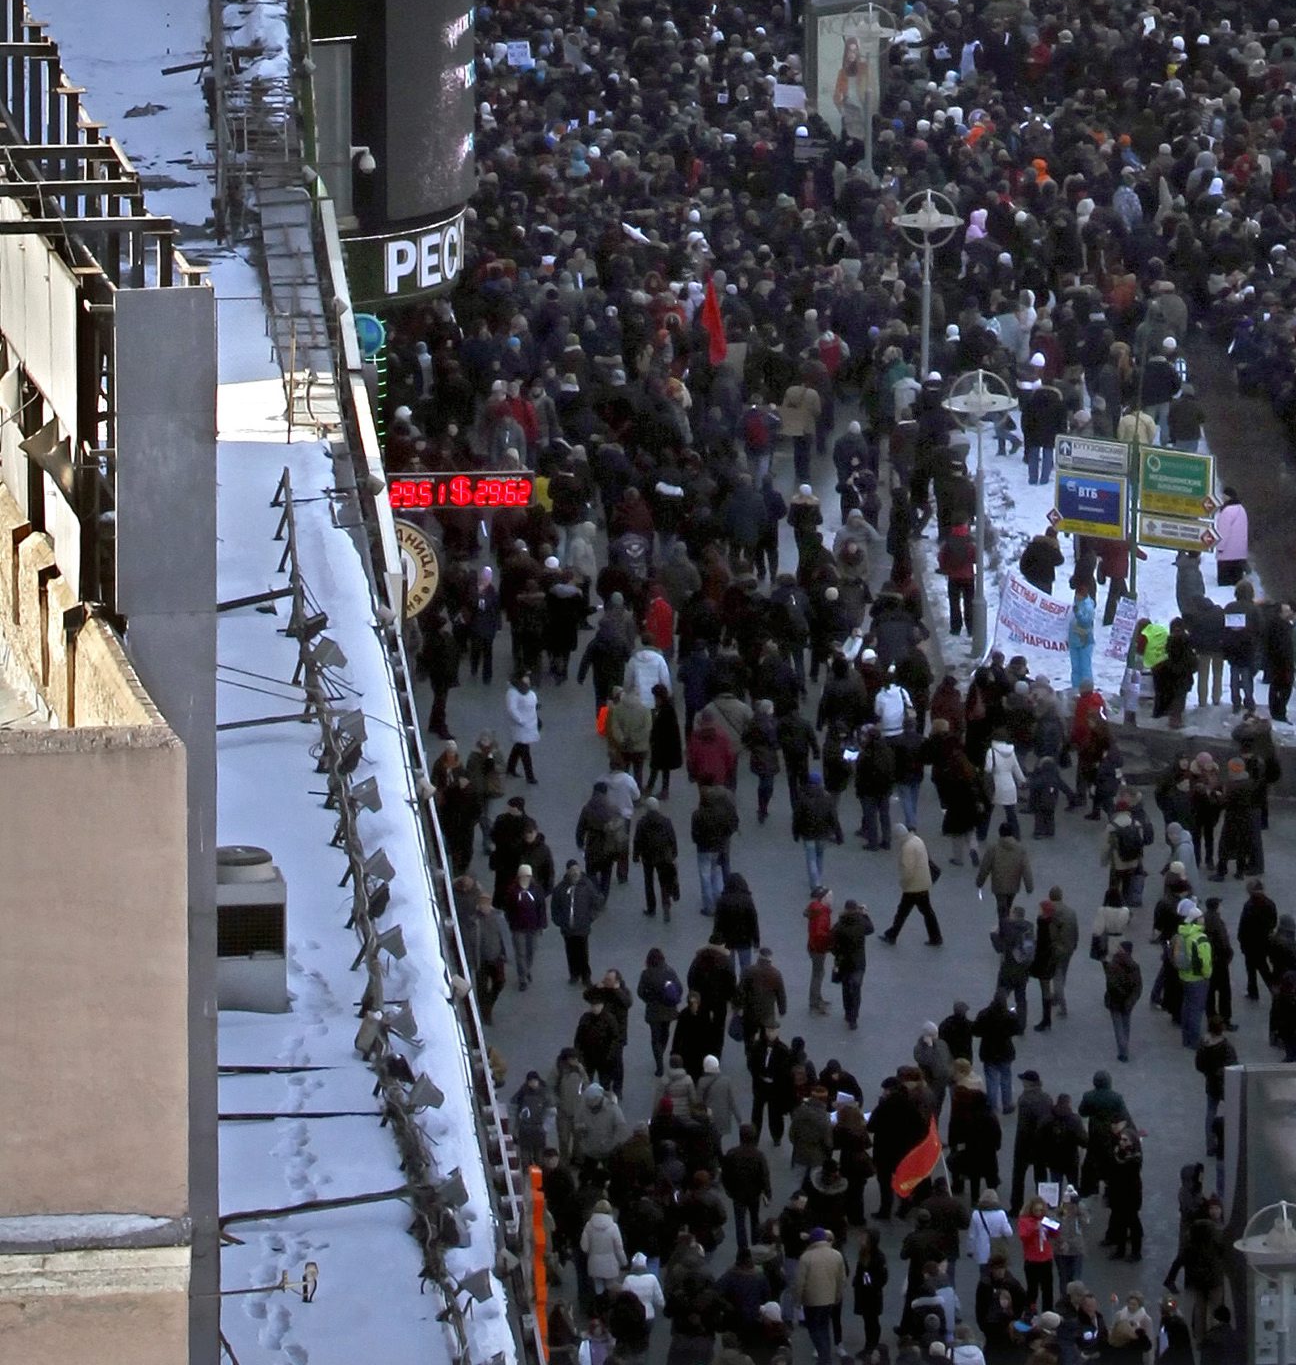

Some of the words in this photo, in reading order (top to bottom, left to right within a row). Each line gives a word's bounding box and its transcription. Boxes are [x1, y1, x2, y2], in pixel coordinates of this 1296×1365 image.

[391, 481, 447, 508] 29.51
[474, 479, 533, 507] 29.62
[1078, 487, 1098, 499] ВТБ
